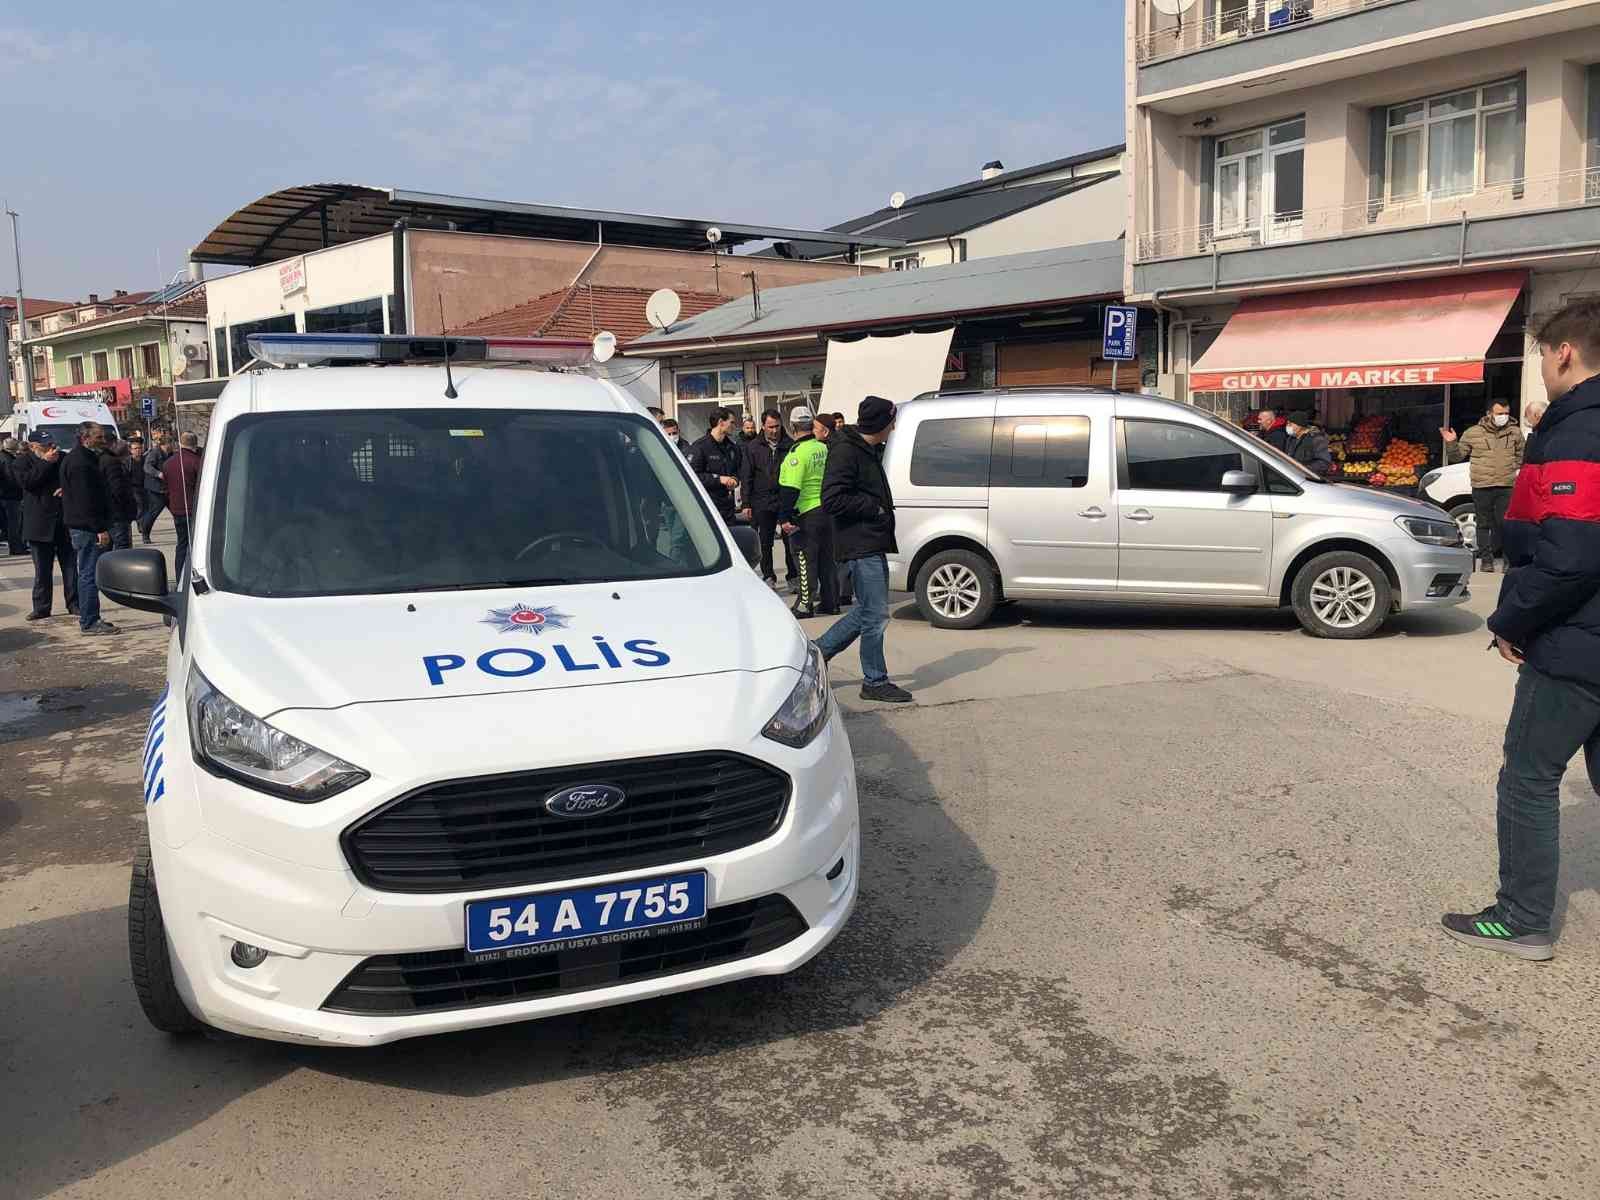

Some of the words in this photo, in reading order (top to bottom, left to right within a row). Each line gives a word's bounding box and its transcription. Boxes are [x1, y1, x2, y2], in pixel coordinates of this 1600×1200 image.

[1108, 310, 1125, 336] P
[1321, 368, 1439, 385] MARKET
[422, 635, 671, 685] POLİS
[566, 790, 608, 811] Ford
[488, 903, 539, 941] 54
[552, 899, 582, 933] A
[595, 881, 690, 926] 7755
[568, 937, 599, 949] USTA
